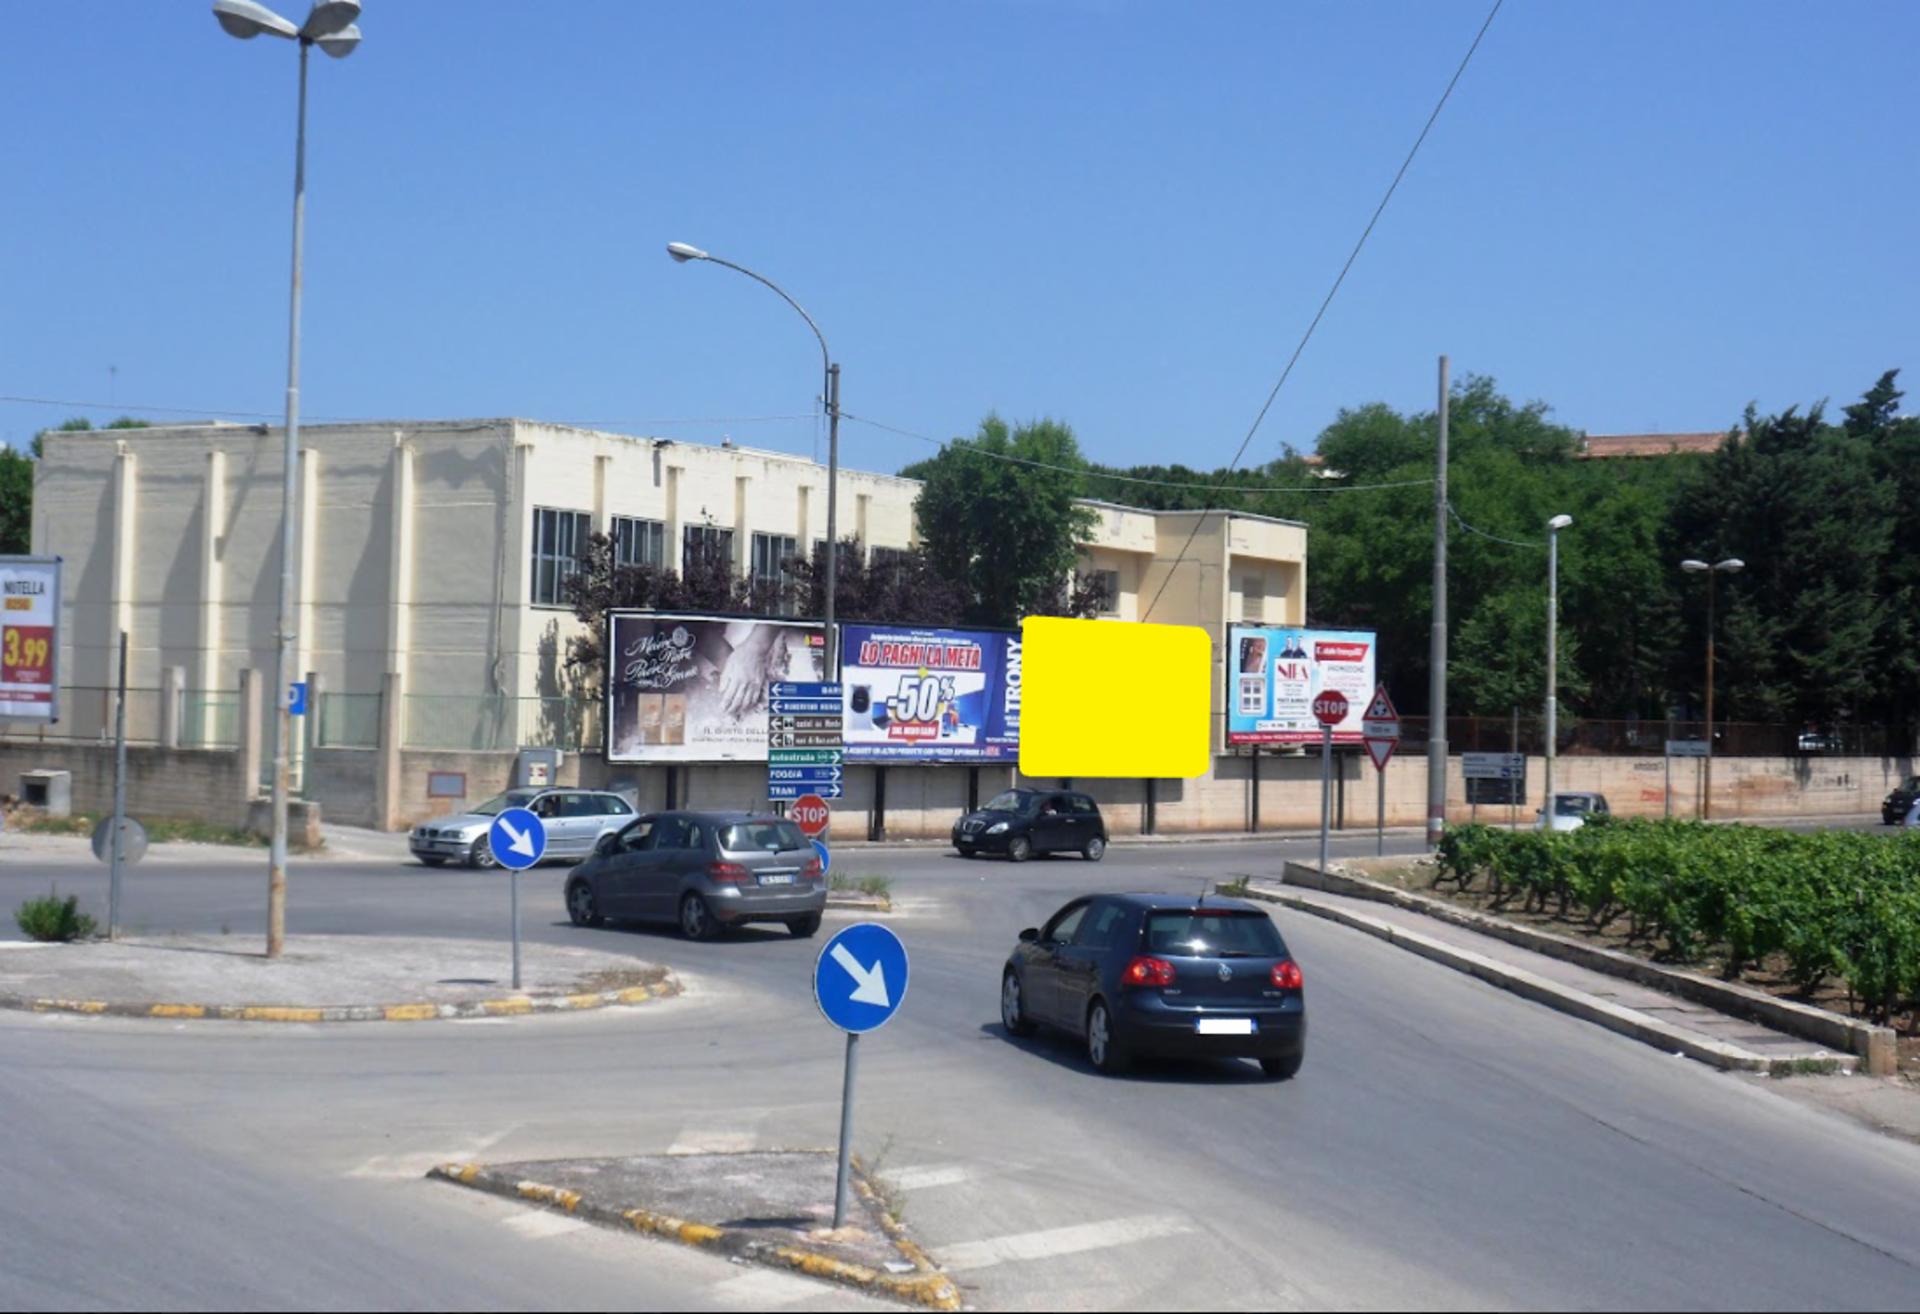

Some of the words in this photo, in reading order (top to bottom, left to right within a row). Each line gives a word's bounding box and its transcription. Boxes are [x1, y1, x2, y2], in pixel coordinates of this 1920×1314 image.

[4, 581, 46, 595] NUTELLA
[4, 628, 48, 667] 3.99
[859, 640, 880, 664] LO
[880, 643, 926, 667] PAGHI
[926, 645, 943, 668] LA
[886, 675, 955, 723] -50%
[1314, 700, 1347, 715] STOP
[770, 753, 815, 761] autostrada
[770, 770, 803, 778] FOGGIA
[770, 787, 796, 795] TRANI
[792, 807, 827, 823] STOP
